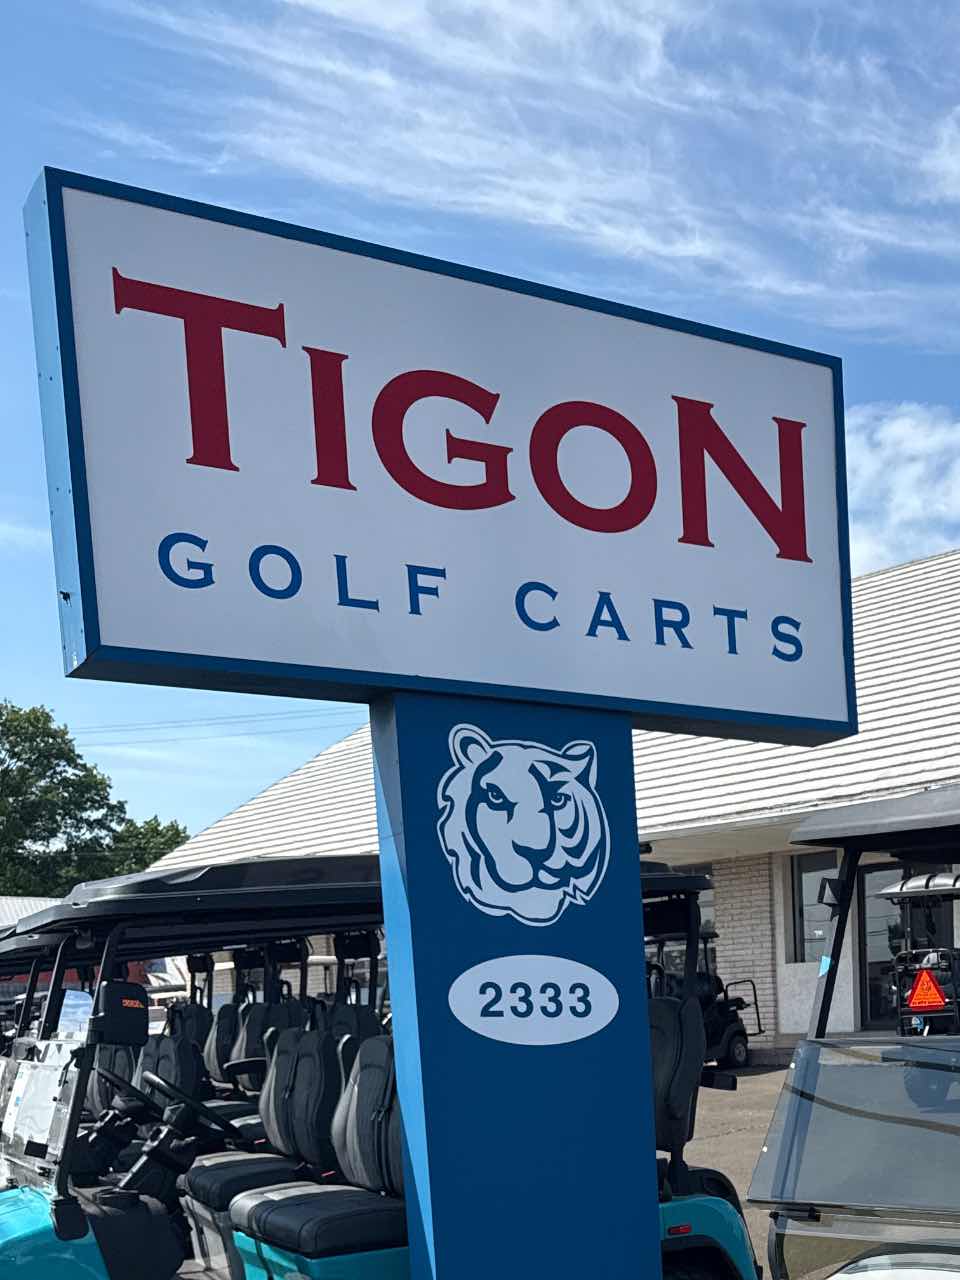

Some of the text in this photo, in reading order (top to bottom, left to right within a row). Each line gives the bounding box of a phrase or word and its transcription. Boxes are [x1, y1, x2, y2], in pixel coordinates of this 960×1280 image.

[112, 267, 812, 563] TIGON
[157, 532, 804, 664] GOLF CARTS
[478, 980, 594, 1020] 2333
